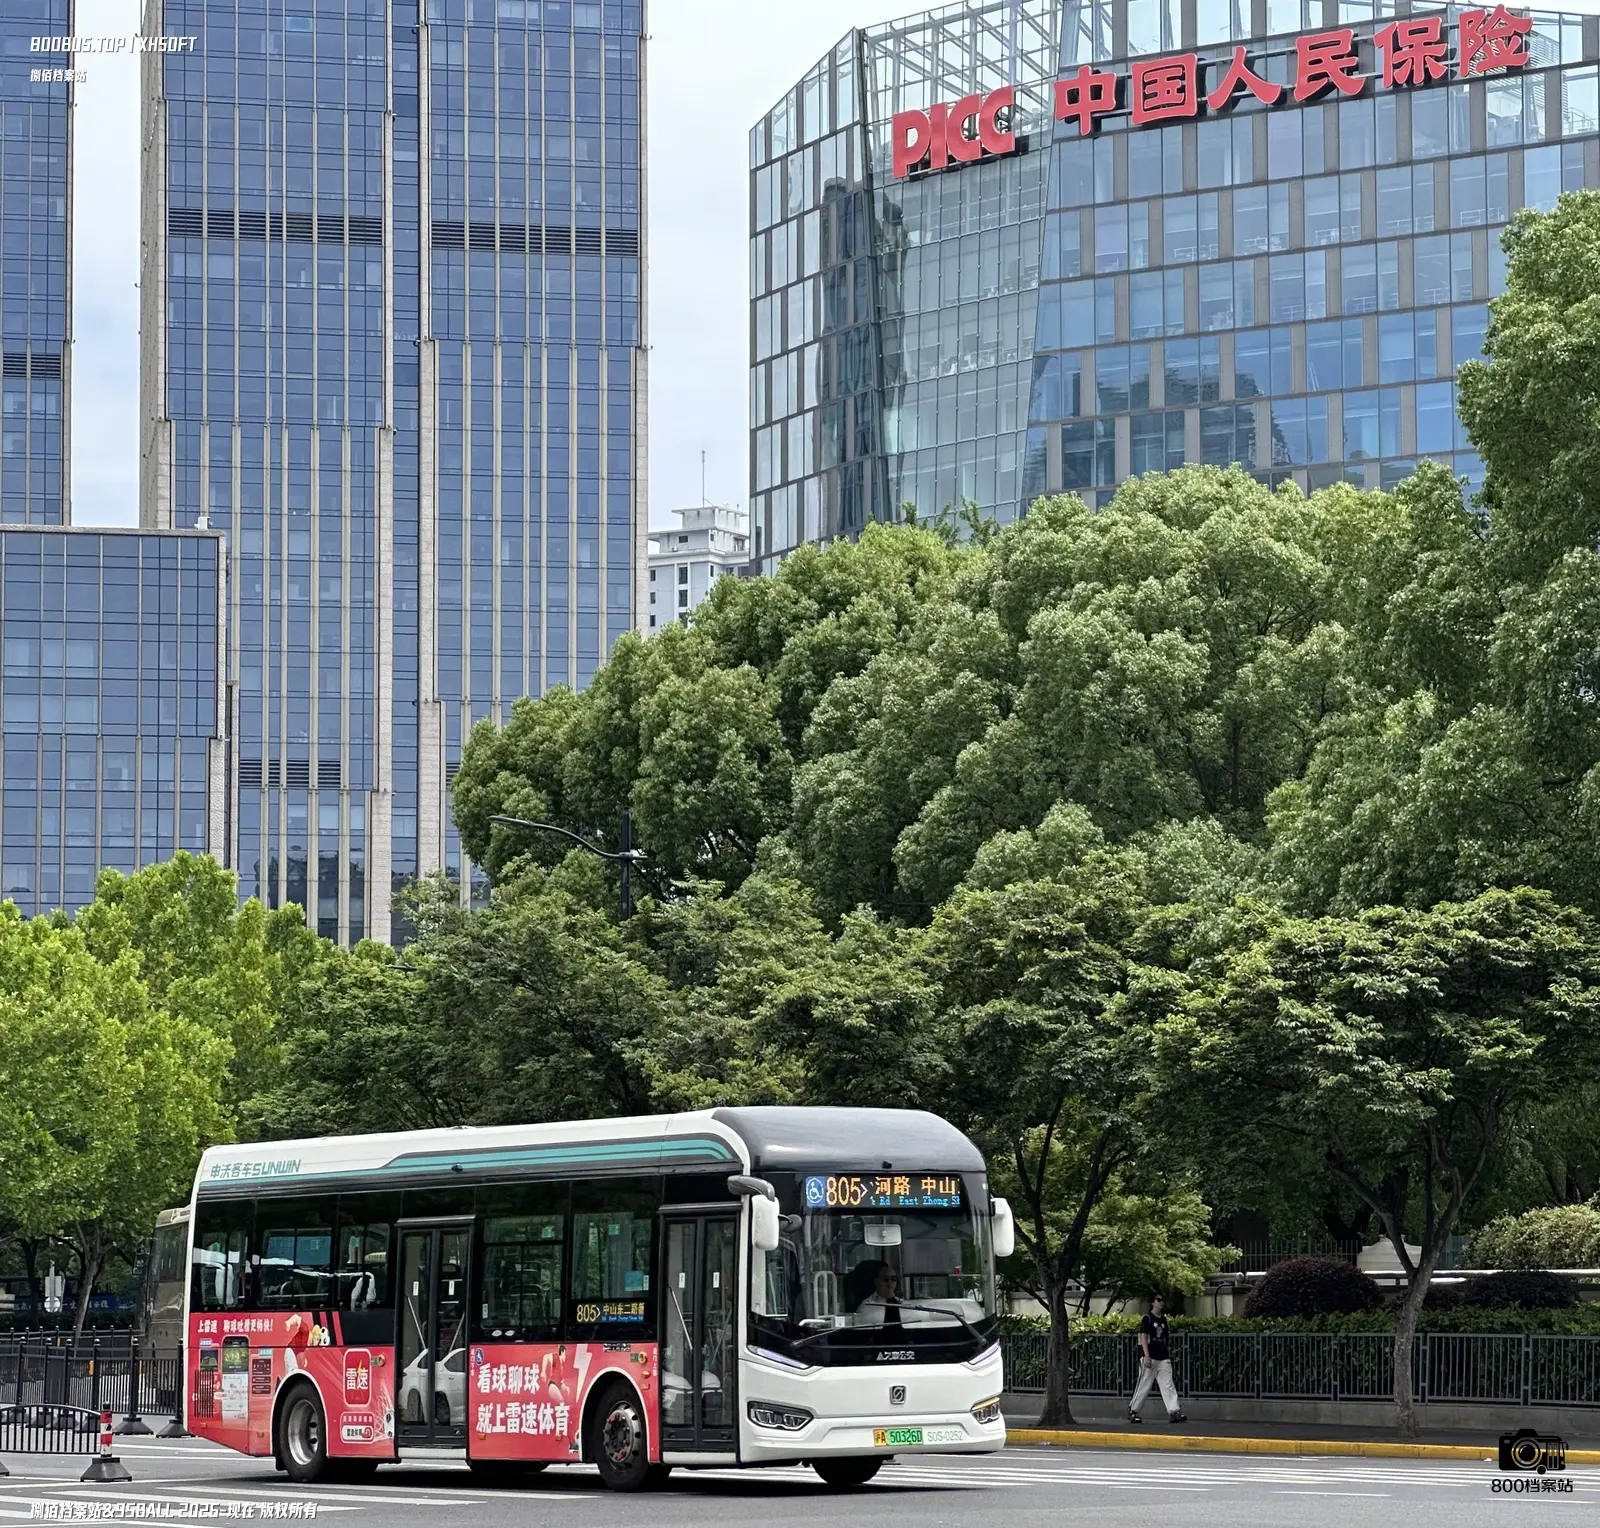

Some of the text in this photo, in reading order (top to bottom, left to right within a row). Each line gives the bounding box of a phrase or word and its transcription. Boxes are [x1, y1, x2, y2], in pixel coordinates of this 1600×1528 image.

[1053, 5, 1533, 136] 中国人民保险
[892, 86, 1016, 179] PICC
[210, 1159, 301, 1178] 申沃客车 SUNWIN
[826, 1177, 861, 1206] 805
[869, 1176, 961, 1195] 河路 中山
[899, 1196, 918, 1206] East
[576, 1304, 597, 1322] 805
[346, 1367, 369, 1390] 雷速
[477, 1362, 541, 1394] 看球聊球
[476, 1402, 570, 1435] 就上雷速体育
[889, 1430, 922, 1443] 50326D
